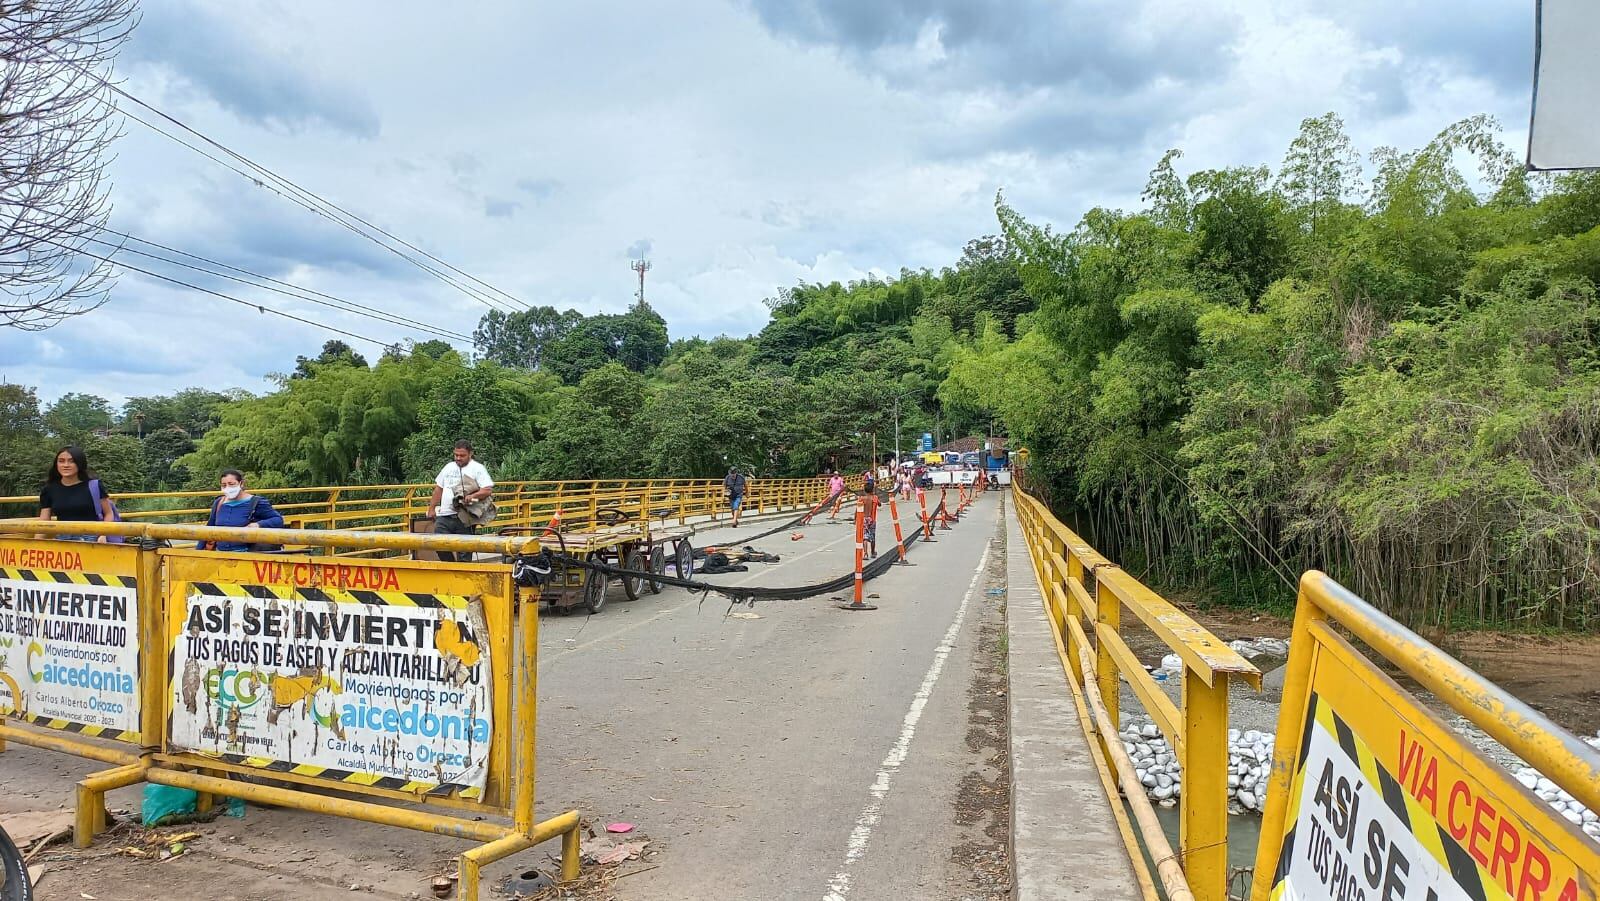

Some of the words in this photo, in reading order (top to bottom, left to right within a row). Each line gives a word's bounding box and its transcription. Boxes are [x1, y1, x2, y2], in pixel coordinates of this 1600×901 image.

[0, 548, 17, 567] VIA
[20, 549, 83, 571] CERRADA
[17, 588, 127, 622] INVIERTEN
[242, 606, 281, 638] SE
[5, 614, 14, 634] DE
[16, 615, 33, 637] ASEO
[33, 618, 40, 638] Y
[42, 619, 126, 648] ALCANTARILLADO
[26, 641, 134, 694] Caicedonia
[44, 643, 100, 662] Moviéndonos
[101, 652, 118, 665] por
[186, 635, 210, 660] TUS
[213, 638, 259, 664] PAGOS
[263, 642, 281, 667] DE
[285, 643, 323, 670] ASEO
[328, 647, 338, 671] Y
[35, 691, 58, 705] Carlos
[60, 696, 88, 709] Alberto
[88, 695, 123, 714] Orozco
[309, 675, 490, 744] Caicedonia
[345, 678, 435, 702] Moviéndonos
[439, 693, 465, 707] por
[327, 738, 365, 754] Carlos
[370, 743, 414, 761] Alberto
[337, 758, 367, 770] Alcaldía
[408, 767, 428, 779] 2020
[1398, 730, 1438, 817] VIA
[1313, 757, 1364, 854] ASÍ
[1363, 818, 1411, 901] SE
[1307, 813, 1332, 885] TUS
